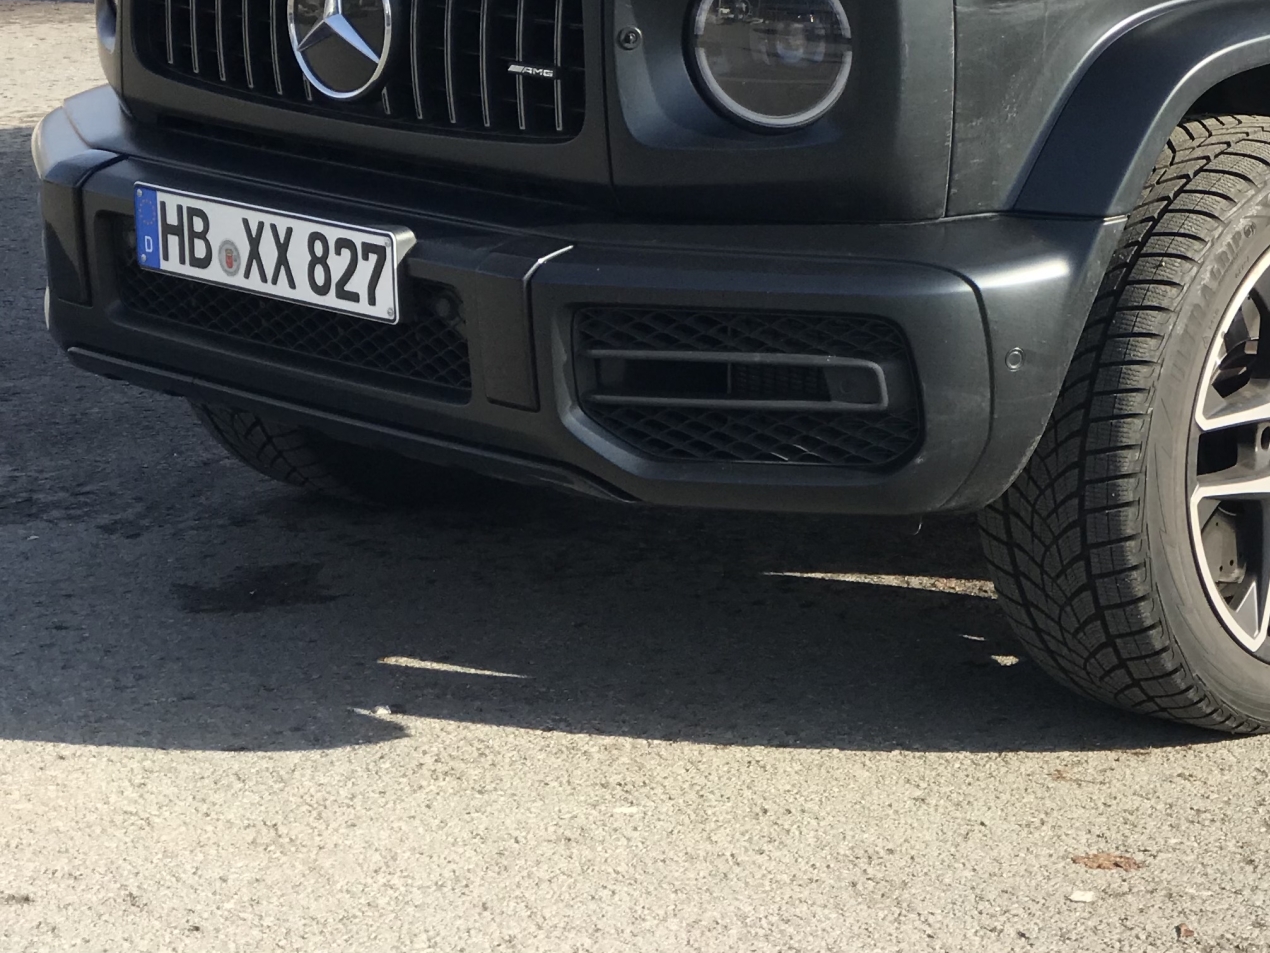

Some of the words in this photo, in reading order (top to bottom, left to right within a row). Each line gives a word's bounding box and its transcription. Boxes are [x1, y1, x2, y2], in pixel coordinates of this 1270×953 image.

[521, 66, 554, 78] AMG
[145, 235, 153, 253] D
[159, 200, 213, 270] HB
[241, 217, 297, 290] XX
[306, 231, 387, 307] 827
